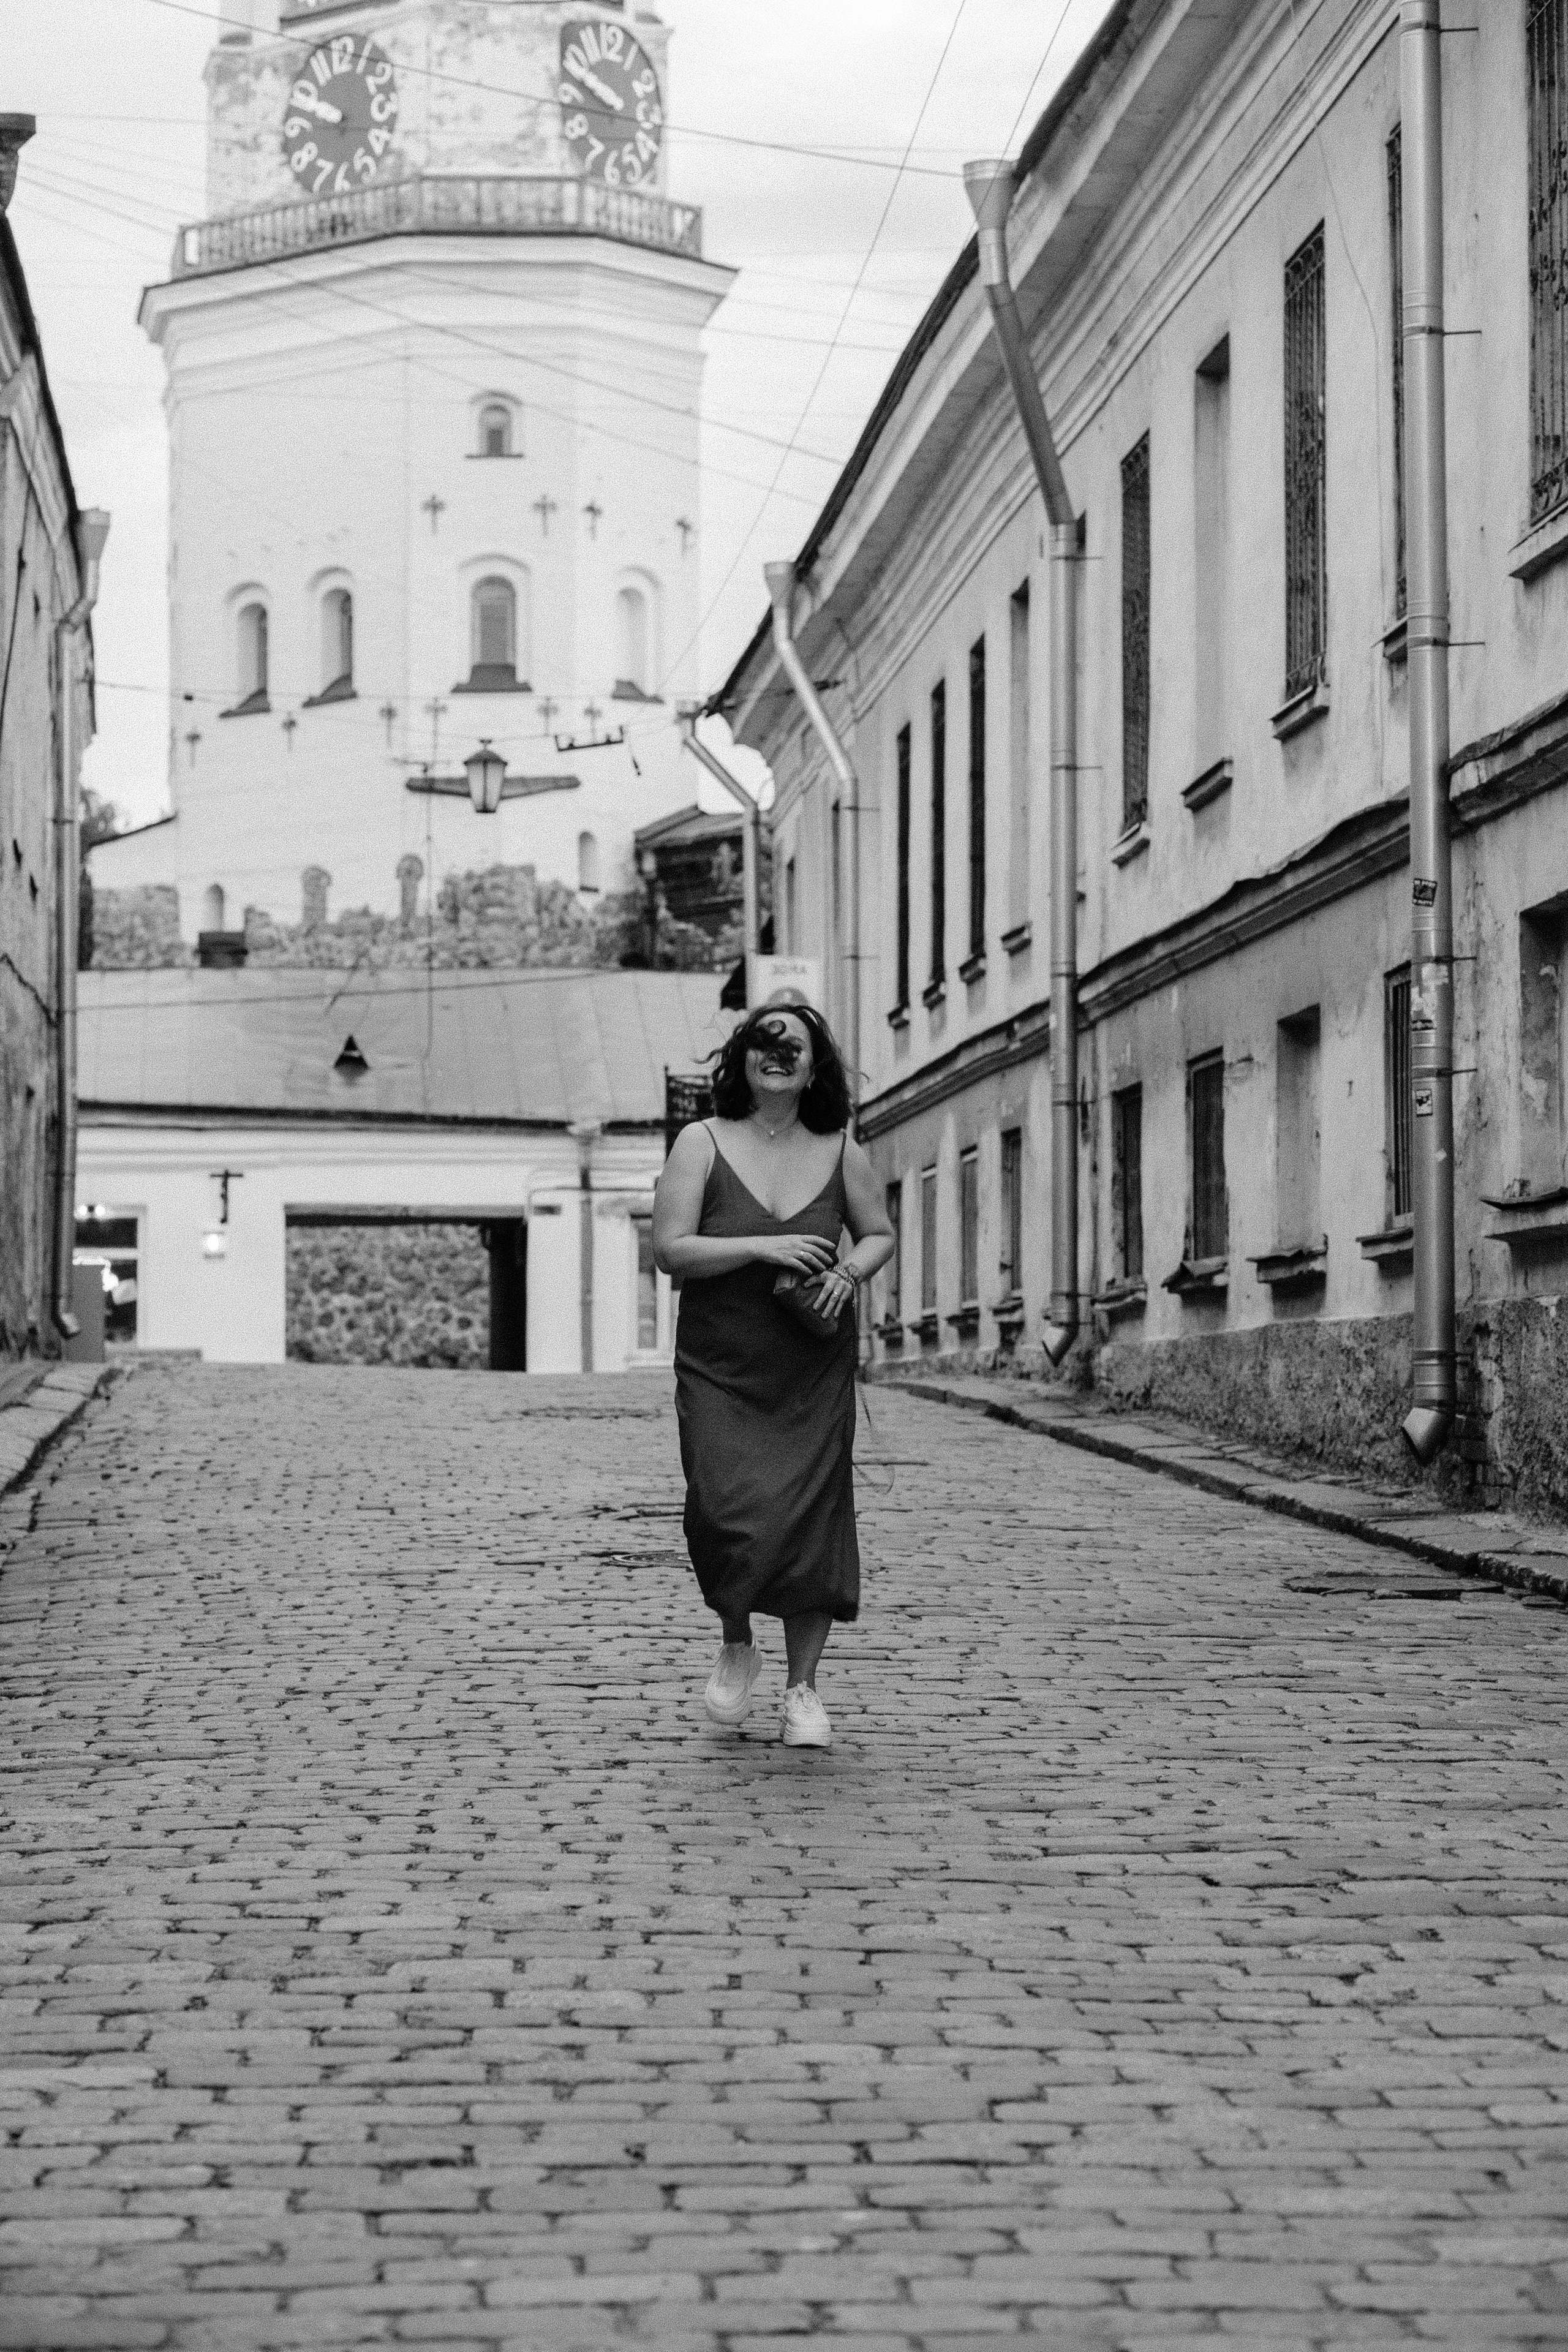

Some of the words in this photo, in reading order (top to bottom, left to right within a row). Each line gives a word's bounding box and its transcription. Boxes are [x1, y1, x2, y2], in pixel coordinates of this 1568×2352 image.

[331, 36, 355, 75] 12
[356, 38, 373, 75] 1
[579, 25, 601, 65] 11
[600, 23, 624, 62] 12
[624, 42, 639, 70] 1
[311, 49, 332, 86] 11
[366, 62, 393, 95] 2
[632, 69, 656, 98] 2
[370, 93, 398, 122] 3
[558, 83, 584, 104] 9
[285, 116, 313, 138] 9
[565, 113, 589, 140] 8
[636, 101, 662, 130] 3
[290, 141, 318, 172] 8
[368, 127, 391, 156] 4
[585, 134, 605, 172] 7
[635, 130, 658, 162] 4
[312, 157, 334, 192] 7
[334, 161, 351, 192] 6
[353, 147, 377, 183] 5
[604, 151, 620, 185] 6
[622, 142, 642, 183] 5
